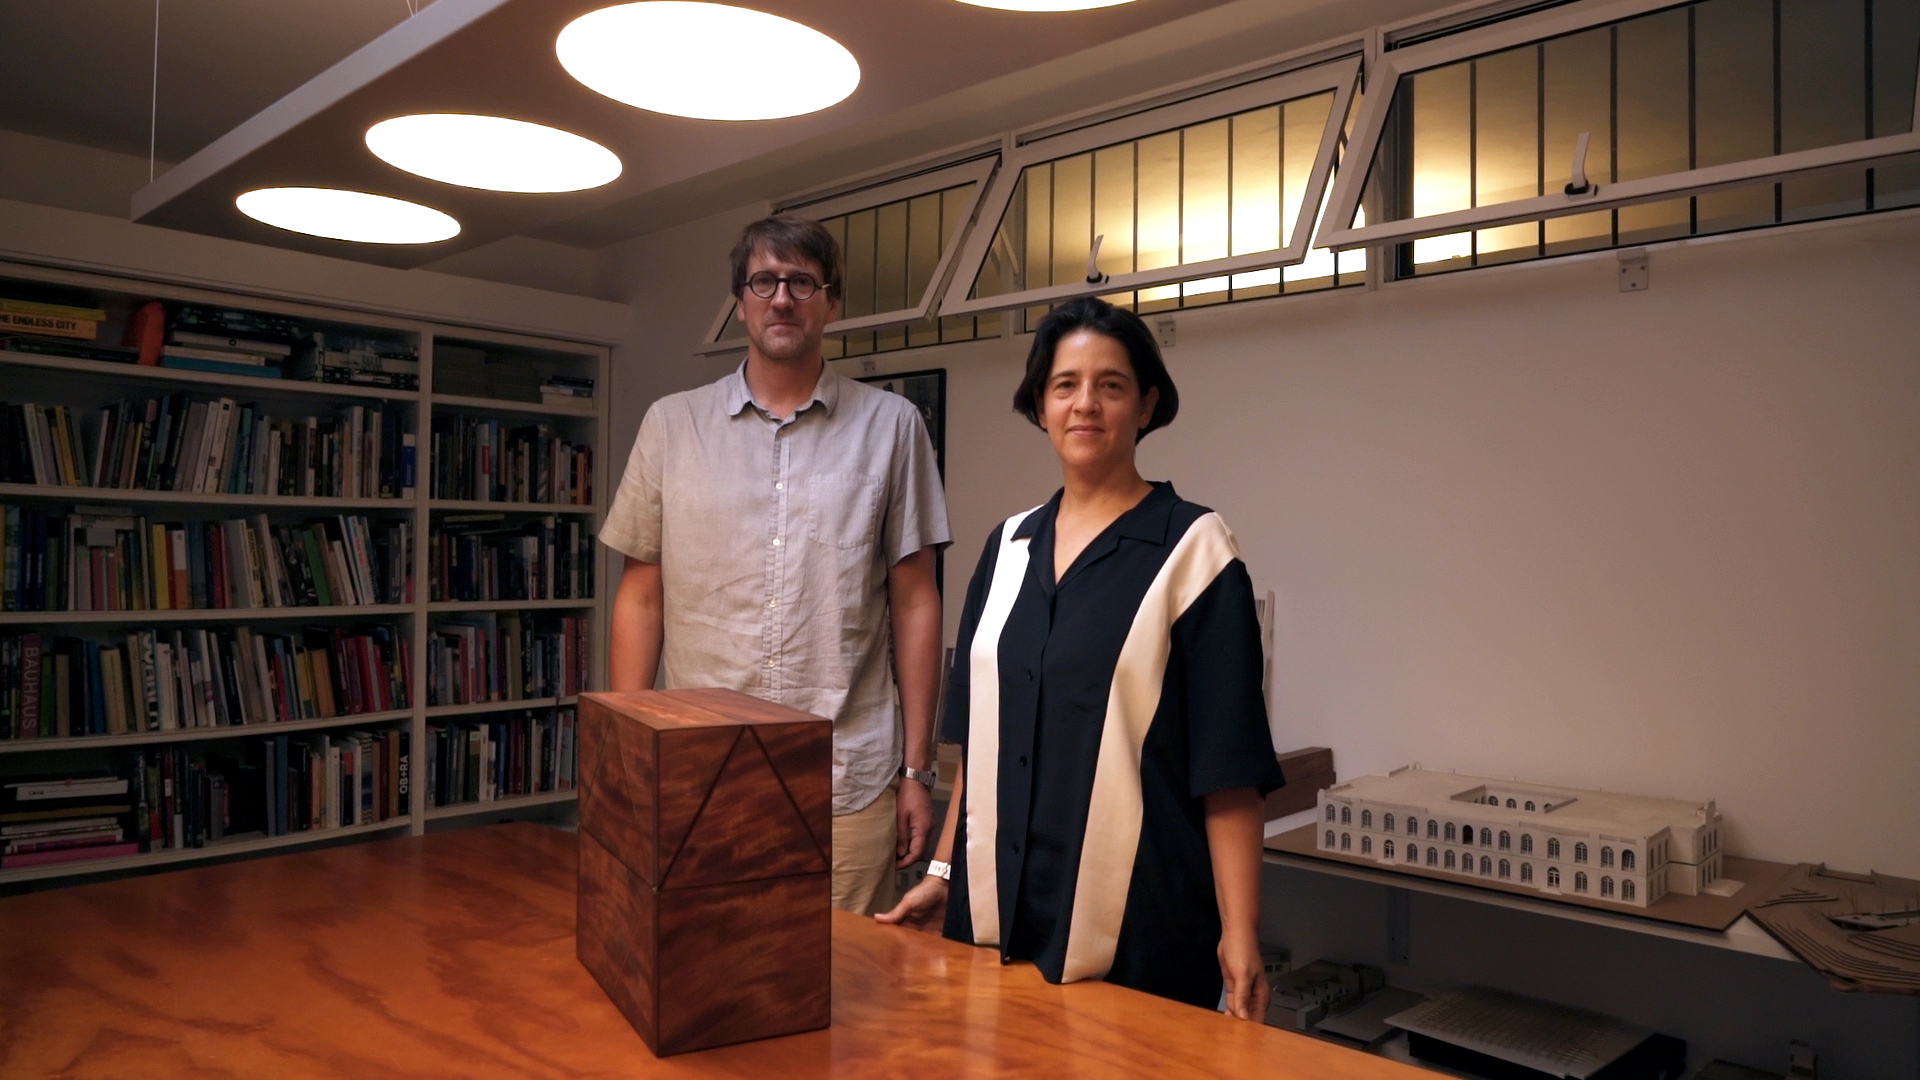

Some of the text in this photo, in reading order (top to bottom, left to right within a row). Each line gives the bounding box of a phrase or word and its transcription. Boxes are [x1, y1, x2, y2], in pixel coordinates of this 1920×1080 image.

[0, 314, 77, 330] HE ENDLESS CITY
[23, 647, 40, 729] BAUHAUS
